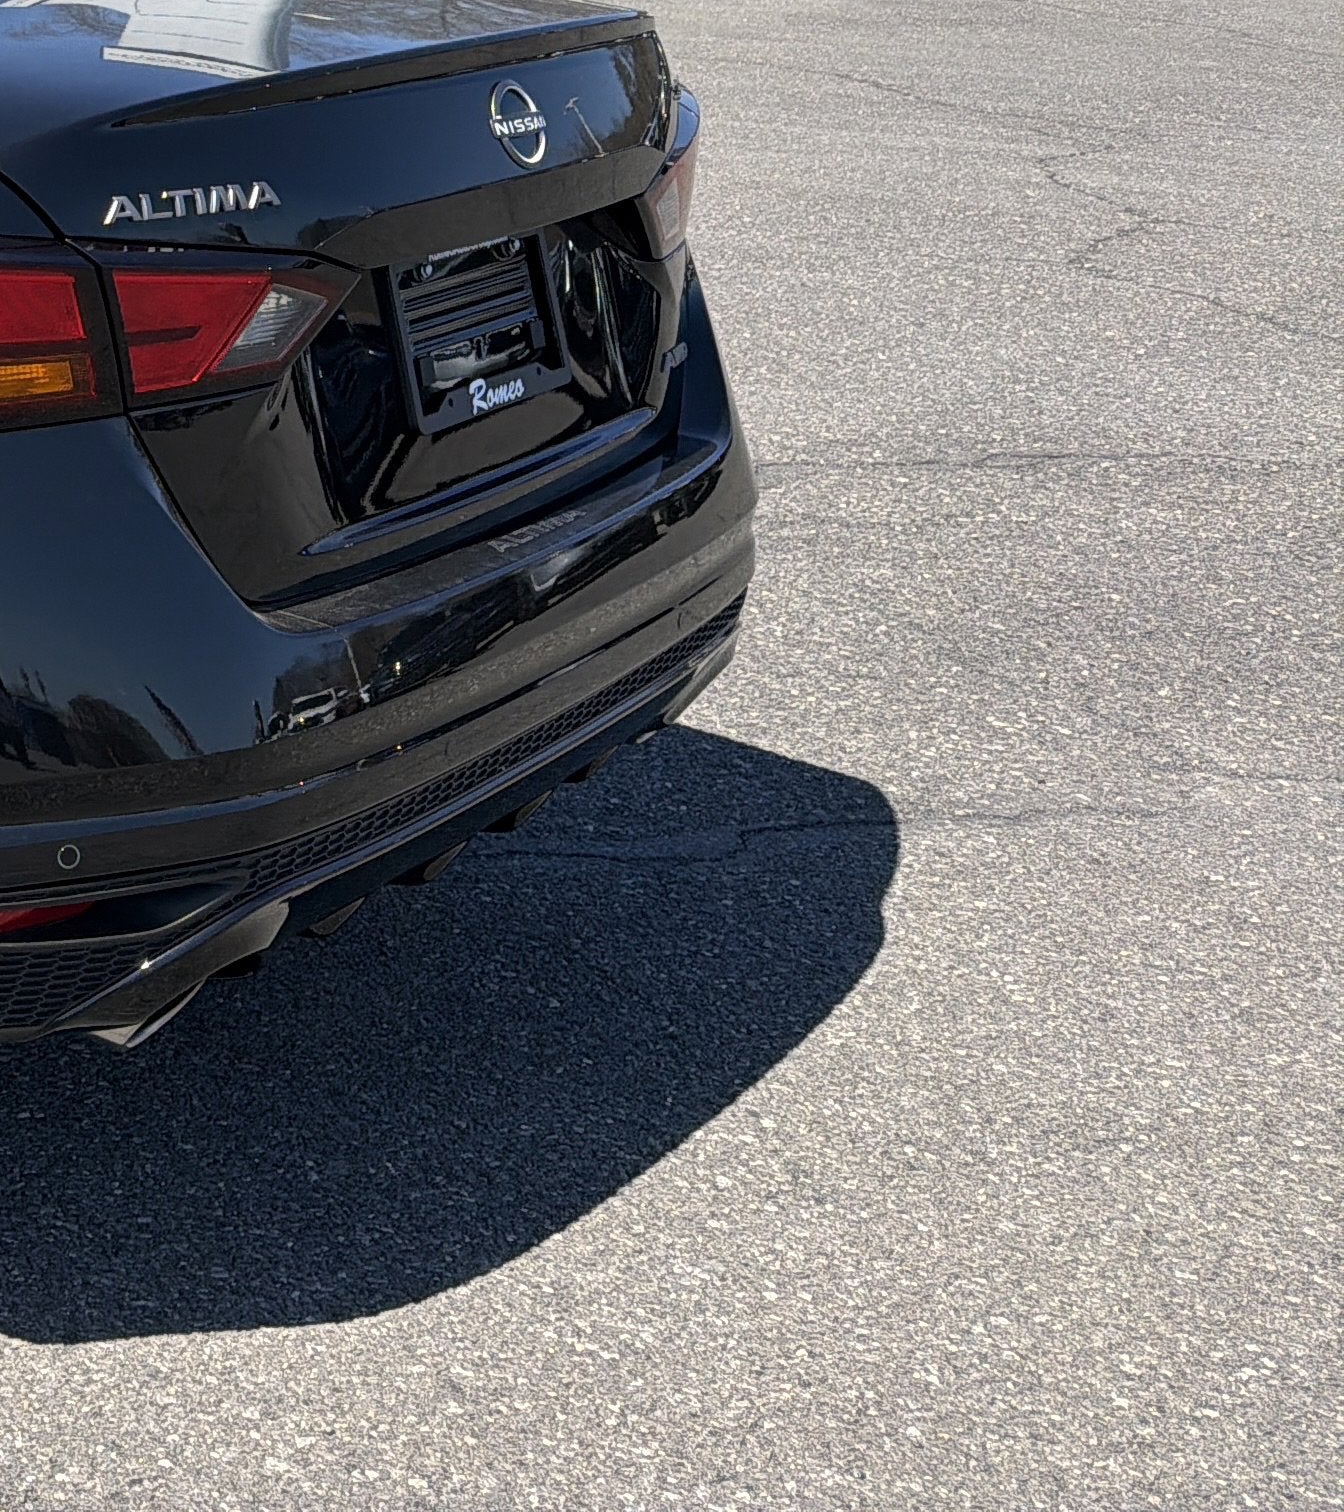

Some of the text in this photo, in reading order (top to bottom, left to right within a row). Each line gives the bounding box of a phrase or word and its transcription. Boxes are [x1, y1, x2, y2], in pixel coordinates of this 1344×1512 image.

[493, 114, 547, 136] NISSAN
[103, 181, 282, 226] ALTIMA
[469, 377, 525, 416] Romeo
